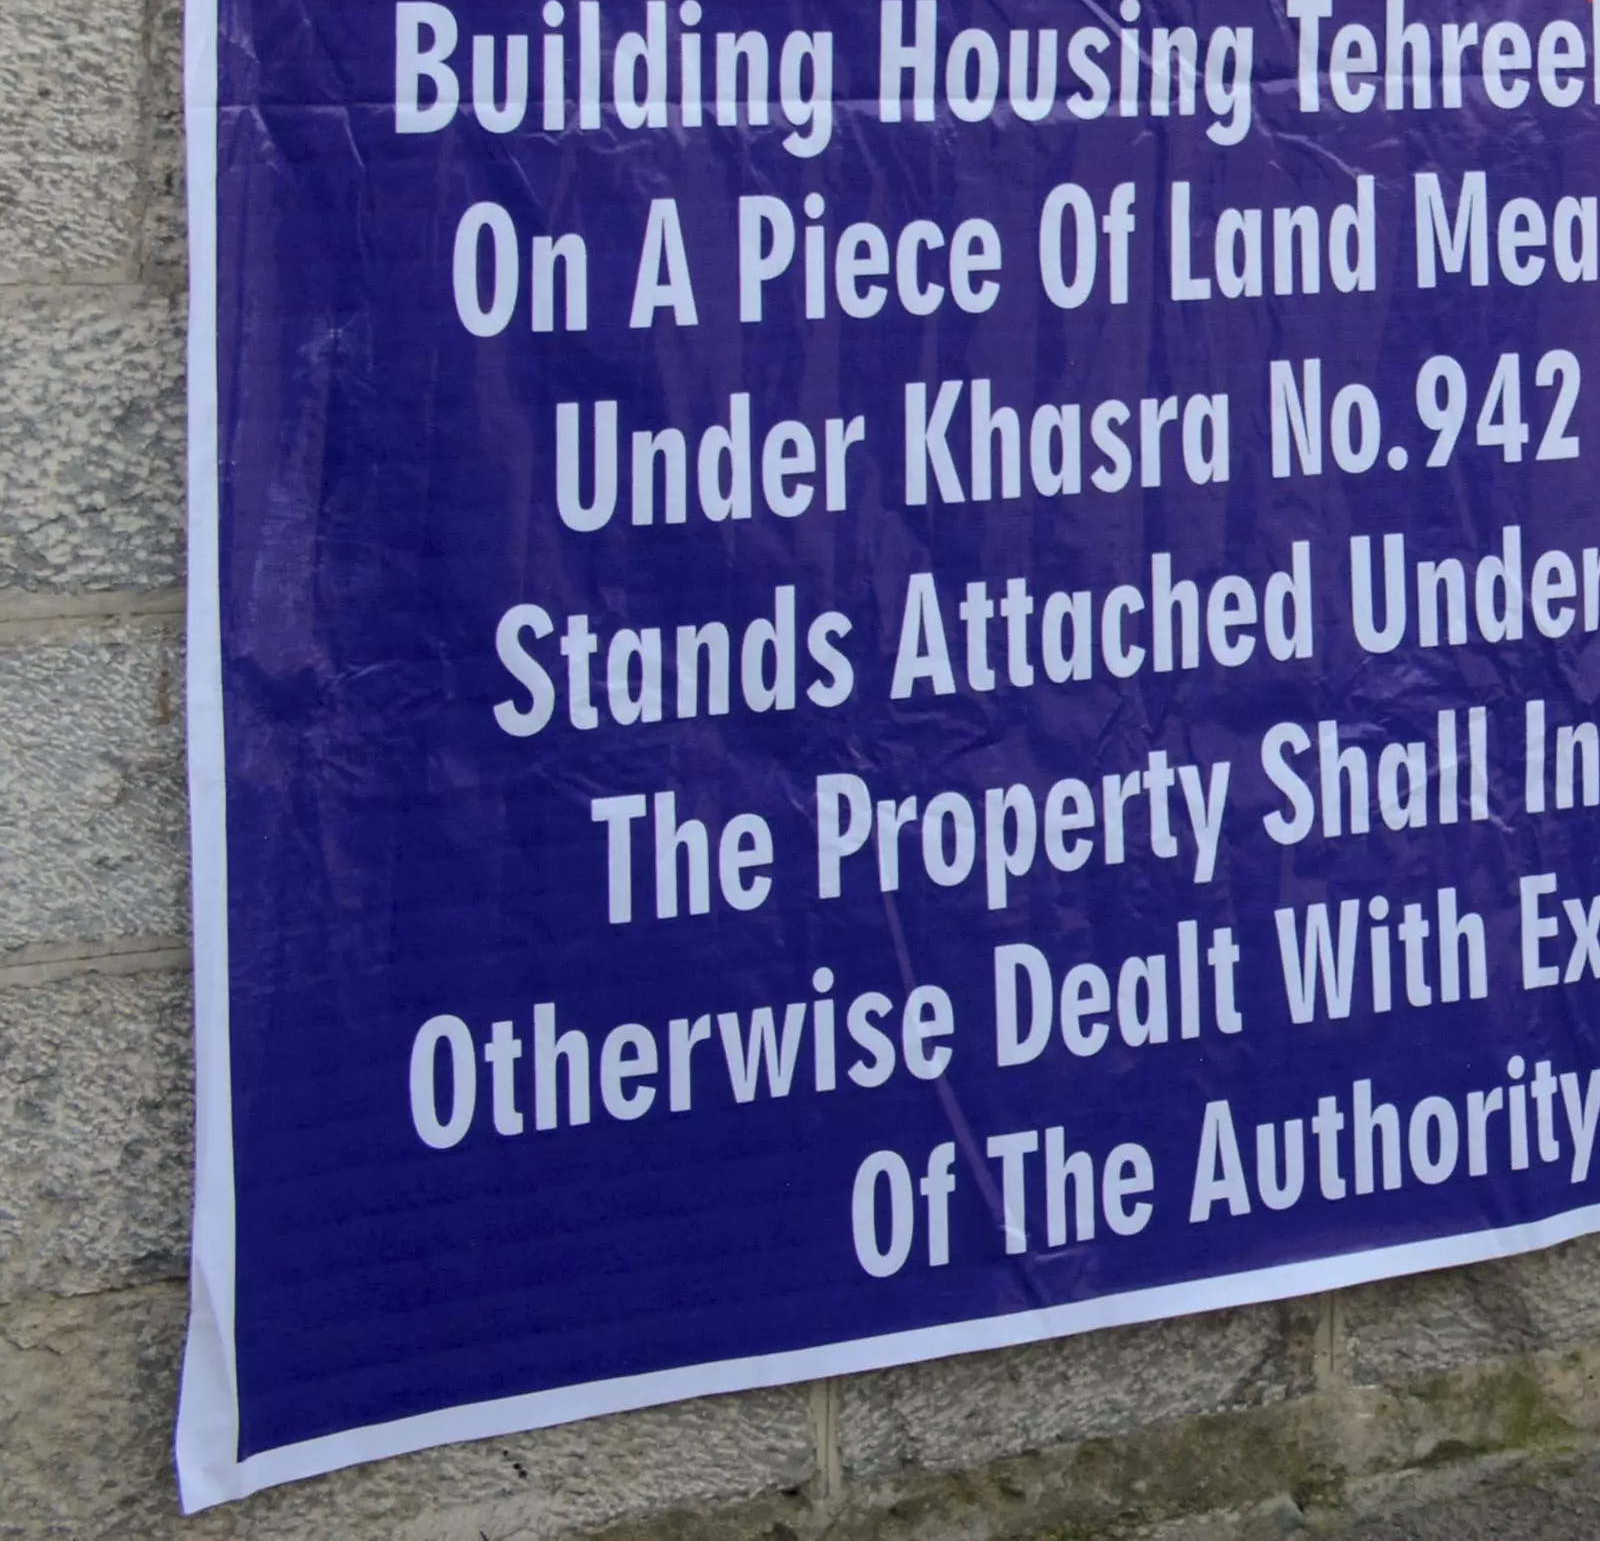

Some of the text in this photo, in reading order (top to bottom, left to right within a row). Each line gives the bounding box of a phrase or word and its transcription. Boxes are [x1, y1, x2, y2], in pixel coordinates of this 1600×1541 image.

[394, 0, 834, 158] Building
[453, 201, 587, 338] On
[629, 198, 699, 329] A
[739, 192, 1002, 323] Piece
[1039, 181, 1136, 309] Of
[1170, 174, 1376, 302] Land
[556, 392, 865, 532] Under
[905, 378, 1230, 506] Khasra
[1270, 349, 1581, 478] No.942
[493, 584, 854, 737] Stands
[890, 540, 1313, 700] Attached
[591, 790, 774, 924] The
[816, 750, 1231, 910] Property
[1261, 706, 1490, 845] Shall
[1525, 699, 1600, 813] In
[409, 967, 954, 1149] Otherwise
[994, 919, 1242, 1067] Dealt
[1274, 887, 1488, 1024] With
[852, 1142, 956, 1278] Of
[987, 1126, 1154, 1254] The
